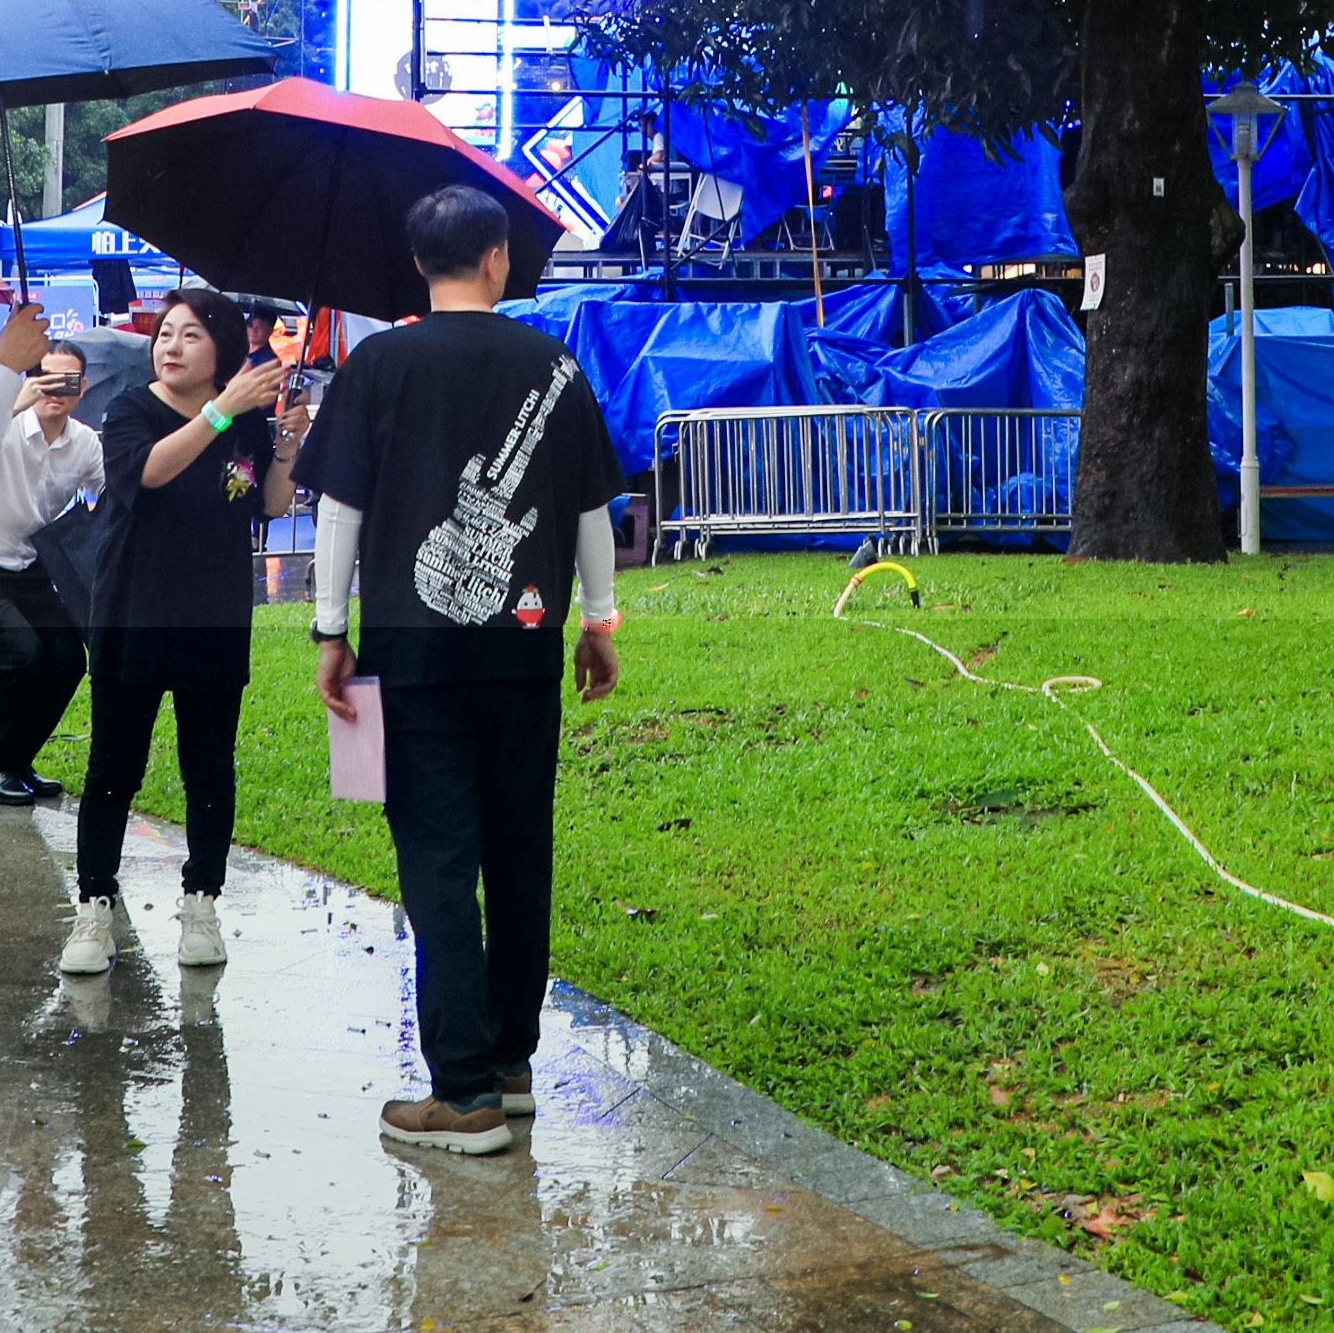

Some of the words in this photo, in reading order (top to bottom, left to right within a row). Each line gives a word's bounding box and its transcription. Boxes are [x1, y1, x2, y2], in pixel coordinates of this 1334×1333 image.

[428, 529, 471, 561] SUMMER
[473, 557, 512, 582] LITCHI
[465, 526, 513, 558] SUMMER
[471, 543, 514, 571] LITCHI
[416, 549, 467, 583] summer
[467, 575, 508, 607] litchi
